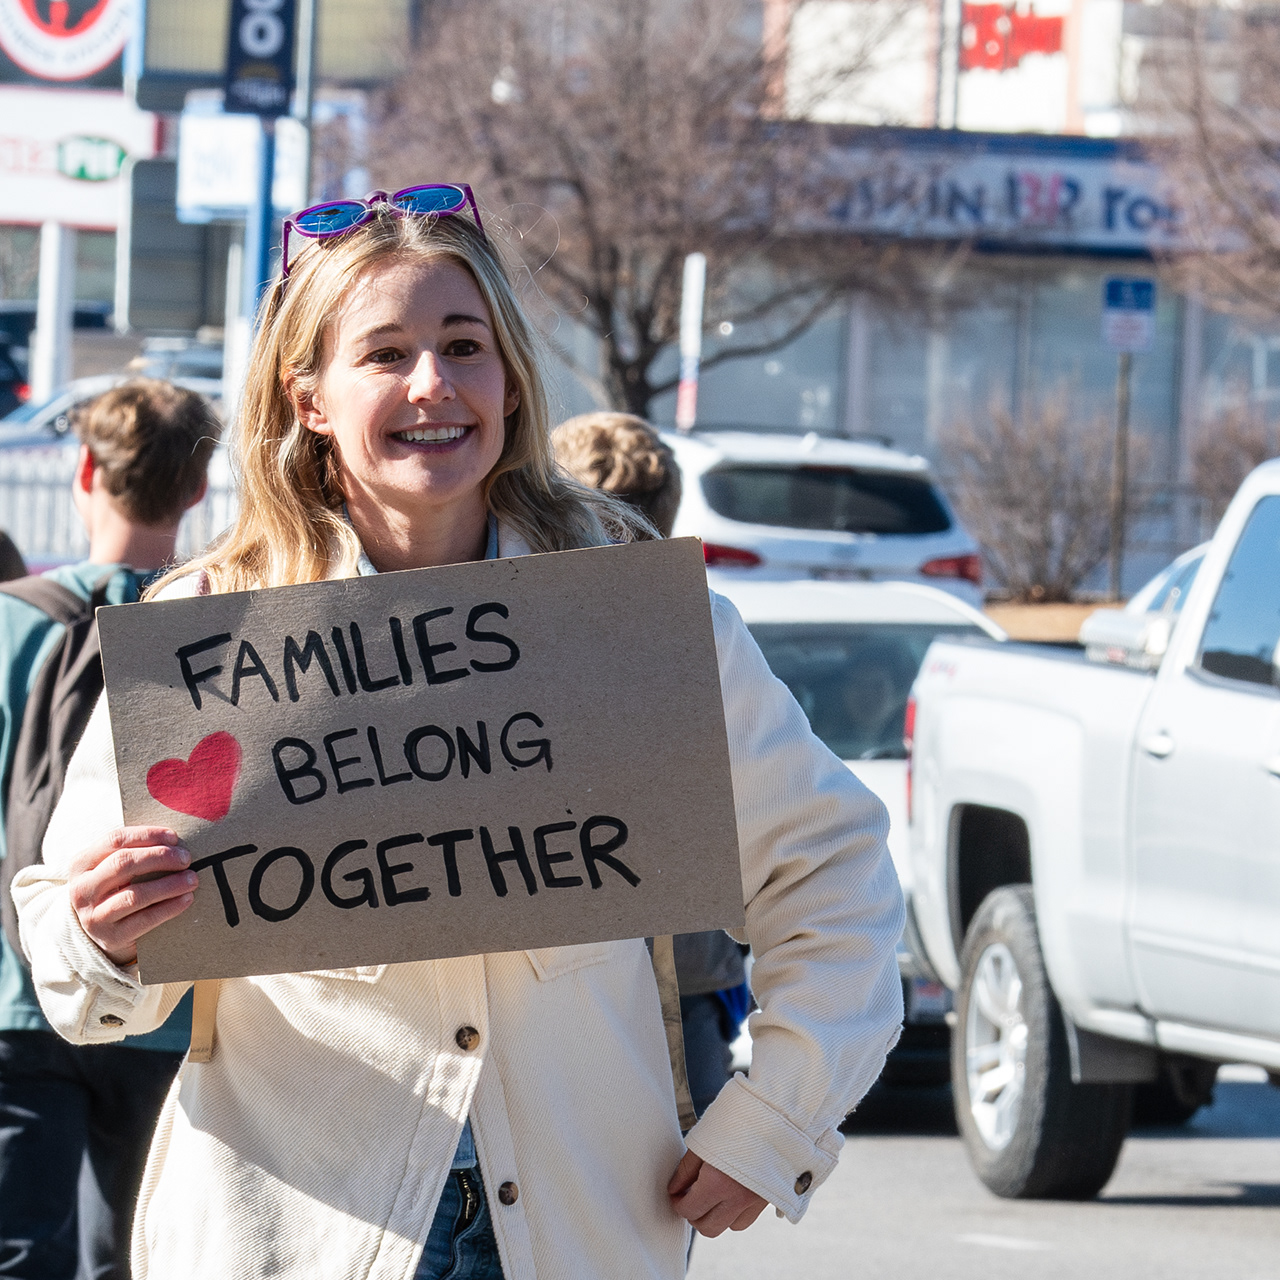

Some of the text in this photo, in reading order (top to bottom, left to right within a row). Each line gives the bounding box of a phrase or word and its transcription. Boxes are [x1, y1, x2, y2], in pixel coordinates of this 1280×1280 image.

[175, 602, 521, 710] FAMILIES
[272, 712, 554, 805] BELONG
[192, 814, 641, 928] TOGETHER
